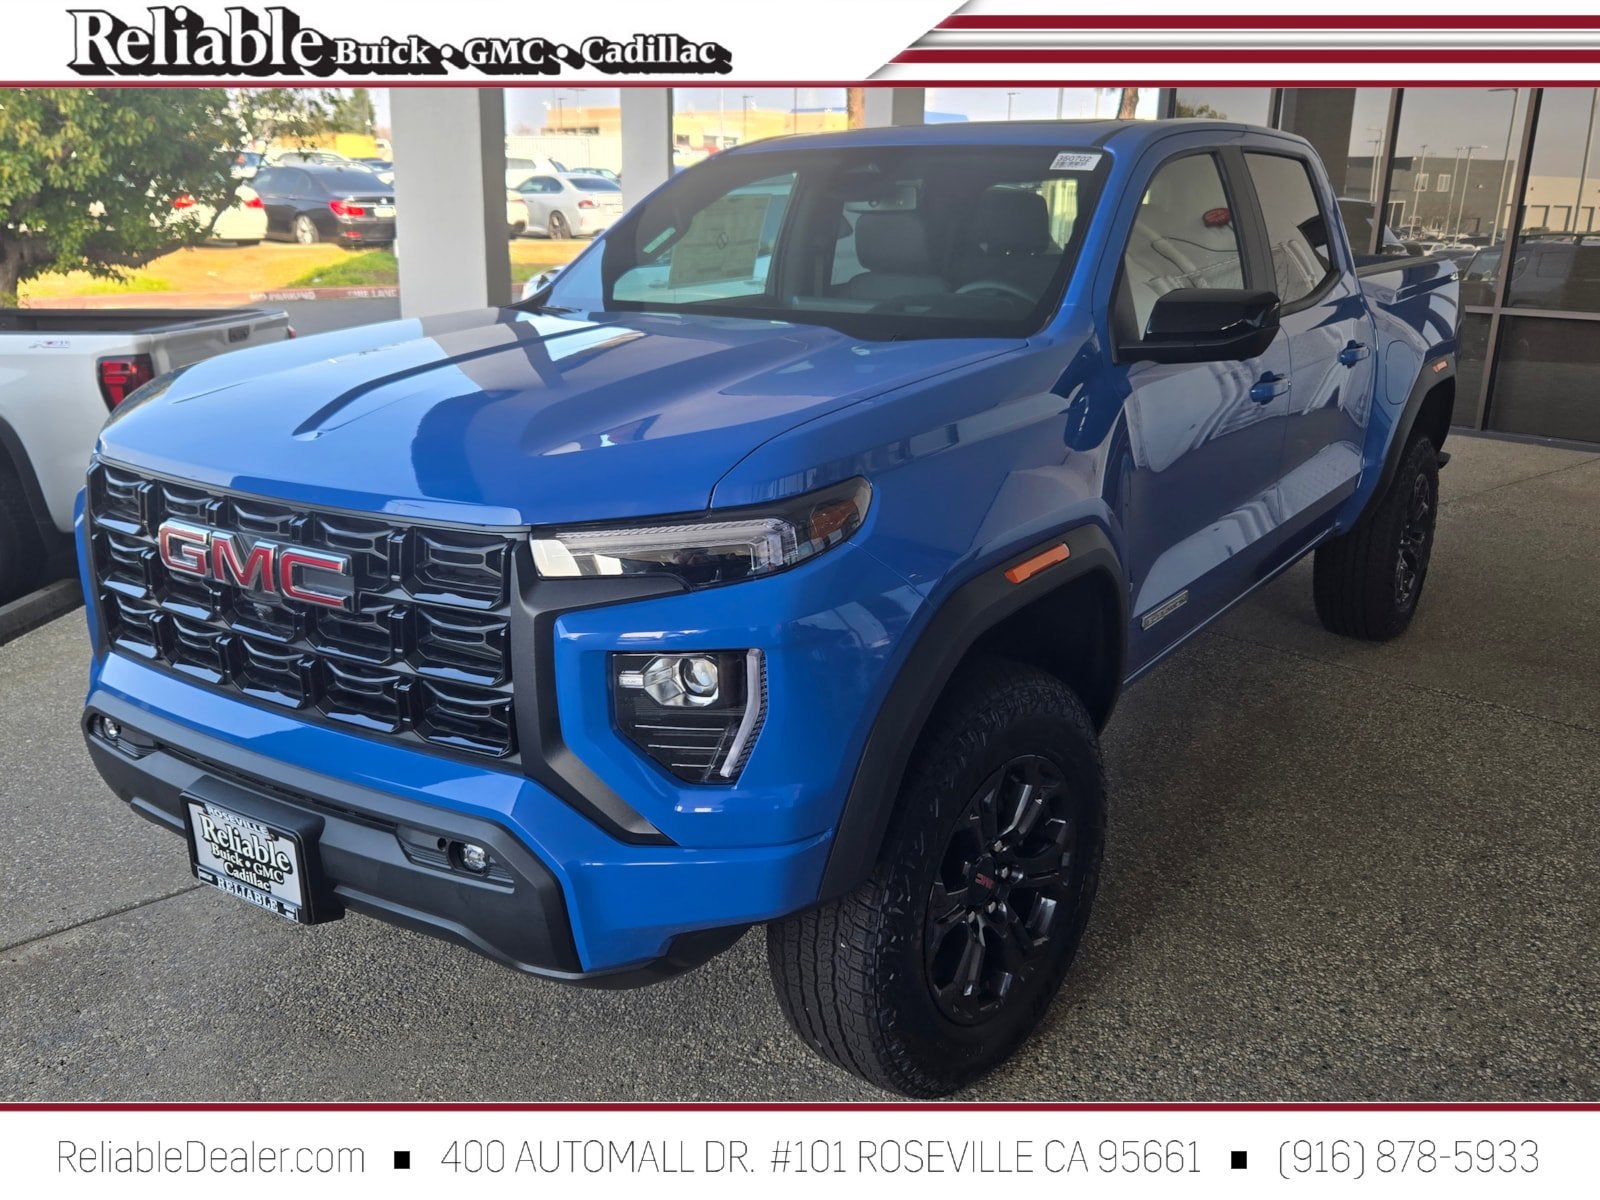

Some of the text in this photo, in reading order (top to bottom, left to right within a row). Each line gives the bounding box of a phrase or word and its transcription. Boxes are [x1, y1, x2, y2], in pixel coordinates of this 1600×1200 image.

[159, 519, 350, 609] GMC
[208, 806, 269, 836] ROSEVILLE
[199, 812, 292, 873] Reliable
[211, 842, 285, 884] Buick GMC
[224, 861, 272, 893] Cadillac
[216, 875, 280, 913] RELIABLE
